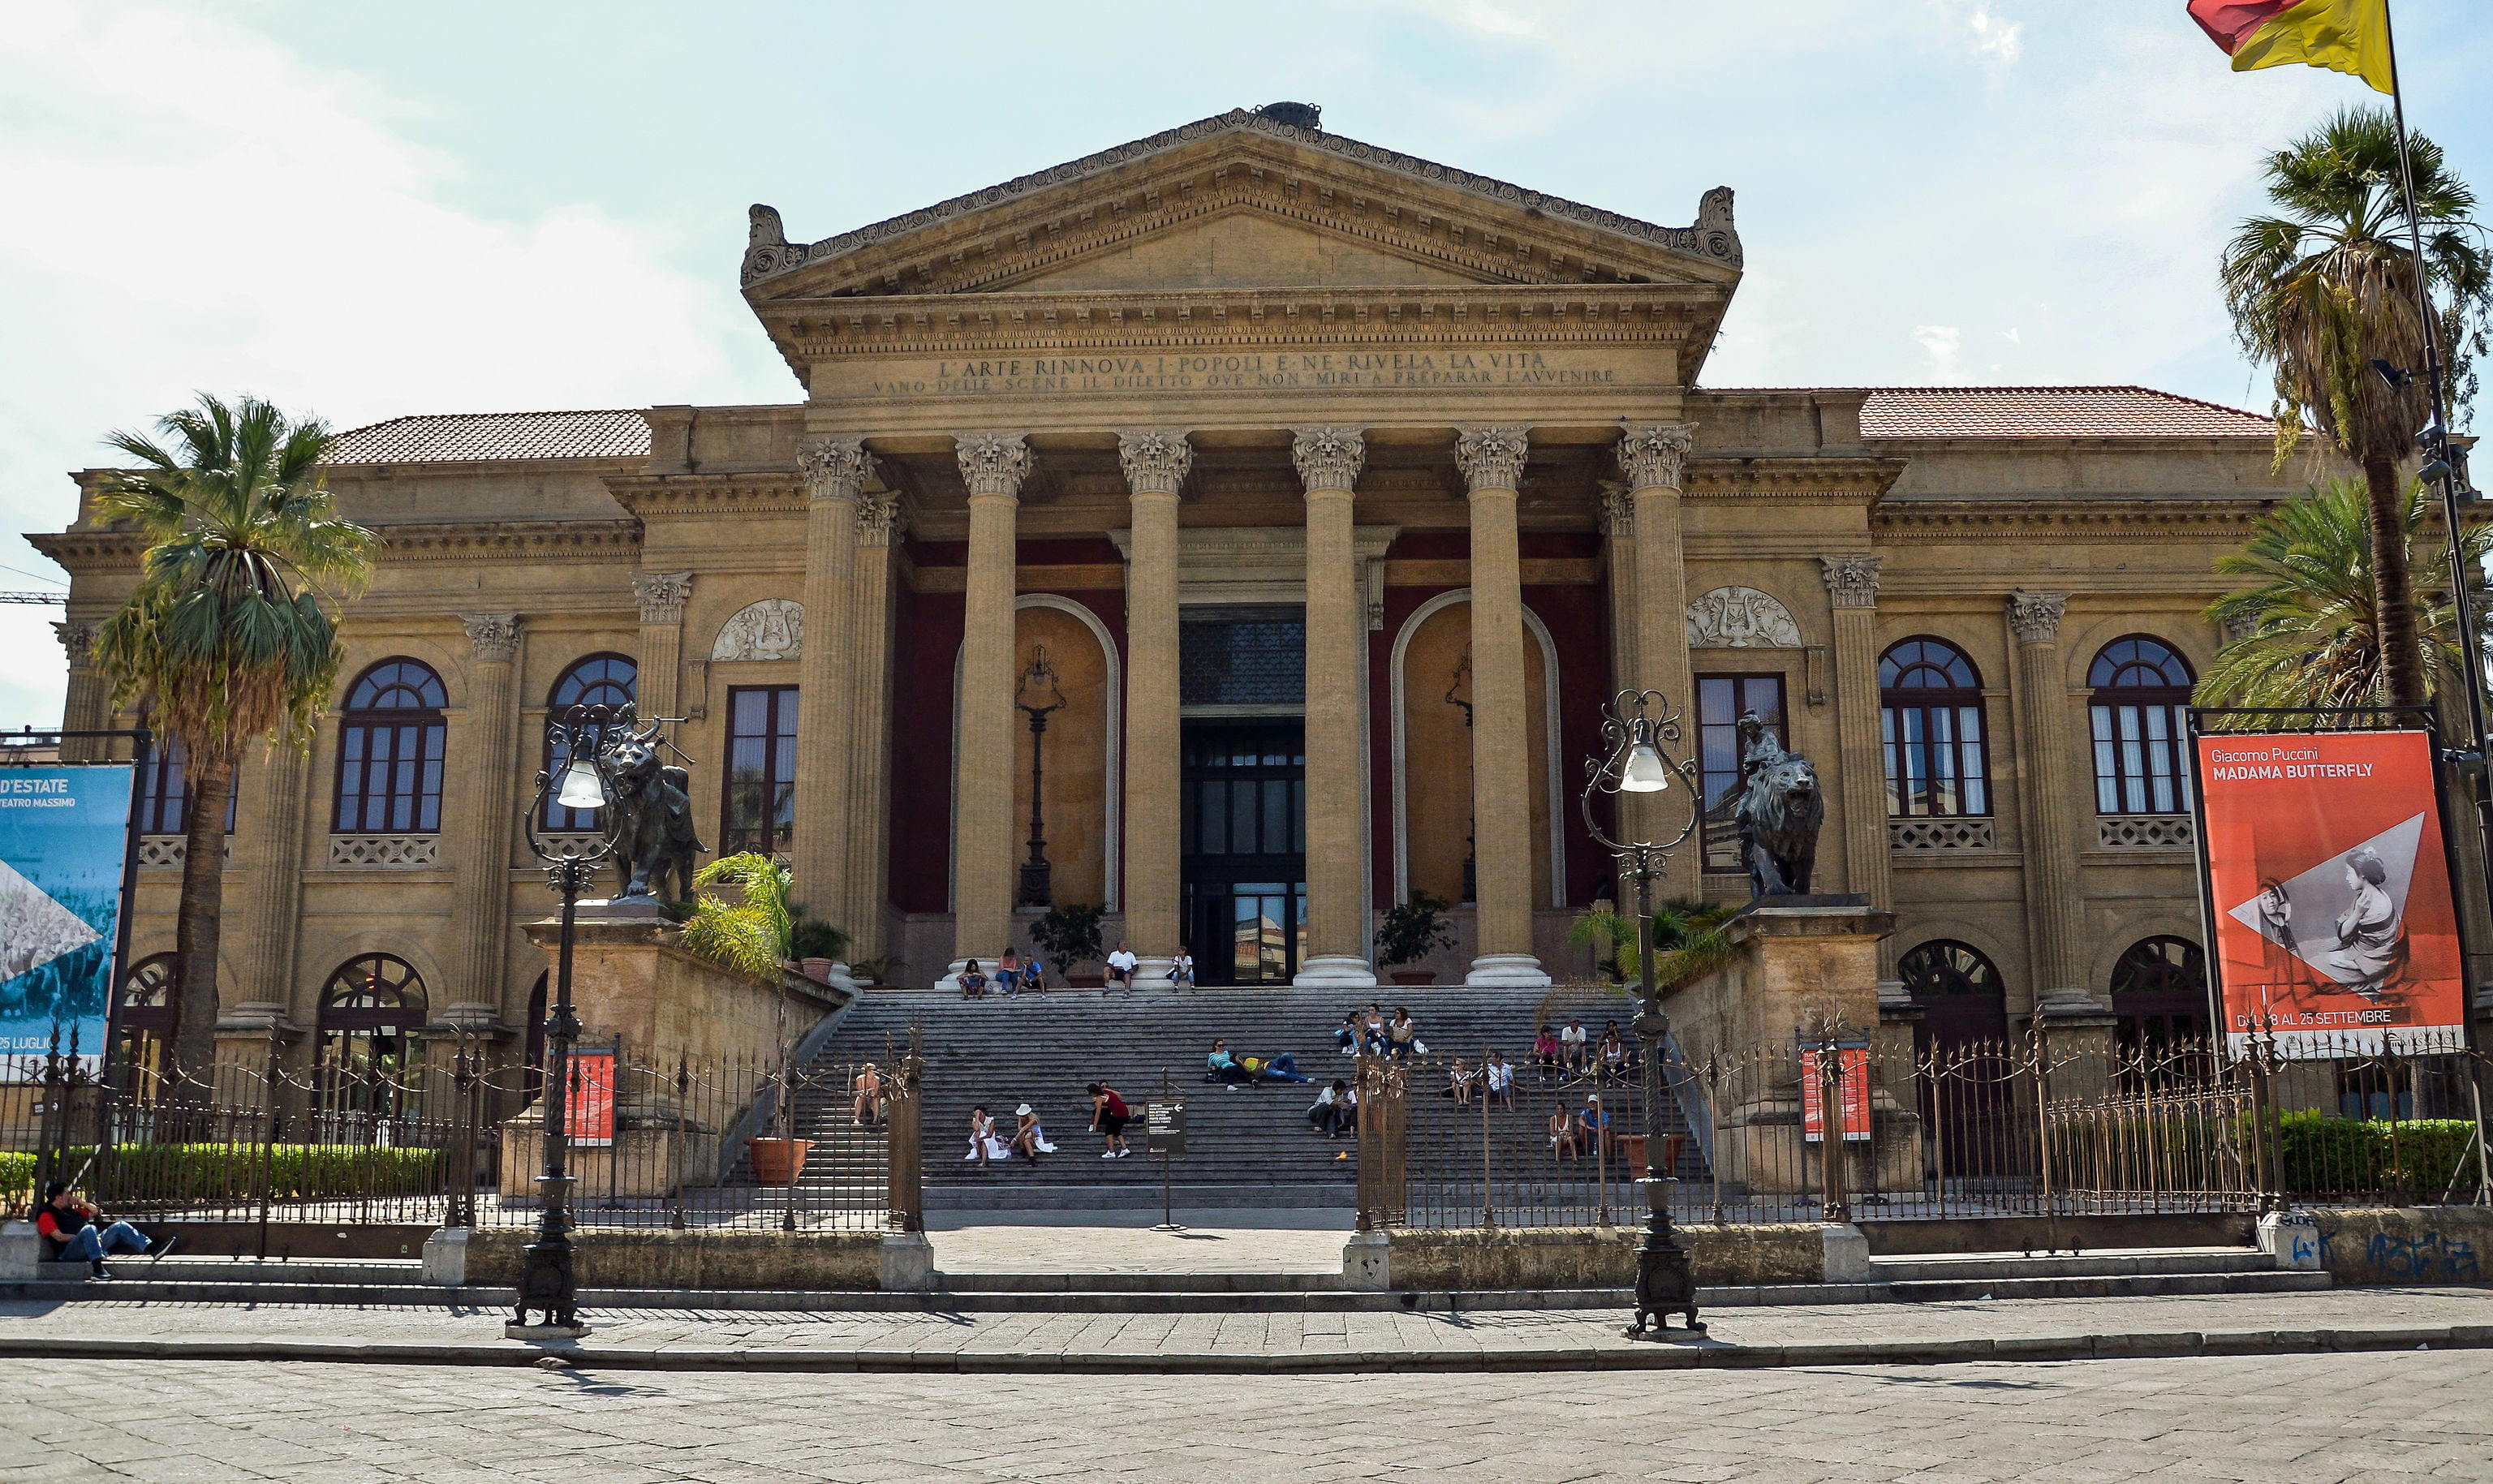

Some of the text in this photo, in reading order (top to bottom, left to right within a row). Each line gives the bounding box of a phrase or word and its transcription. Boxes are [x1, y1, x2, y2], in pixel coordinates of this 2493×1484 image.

[1036, 358, 1144, 375] RINNOVA
[1157, 357, 1164, 372] I
[1179, 356, 1261, 372] POPOLI
[1277, 355, 1287, 371] E
[1302, 355, 1333, 370] NE
[1349, 354, 1434, 370] RIVELA
[1450, 354, 1475, 368] LA
[1489, 353, 1546, 368] VITA
[874, 370, 1613, 394] VANO DELLE SCENE IL DILETTO OVE NON MIRI A PREPARAR L'AVVENIRE
[2211, 747, 2319, 763] Giacomo Puccini
[2213, 764, 2373, 781] MADAMA BUTTERFLY
[0, 779, 69, 794] D'ESTATE
[33, 798, 75, 807] MASSIMO
[2237, 1013, 2263, 1027] DL
[2281, 1013, 2297, 1025] AL
[2300, 1013, 2313, 1025] 25
[2316, 1010, 2391, 1024] SETTEMBRE
